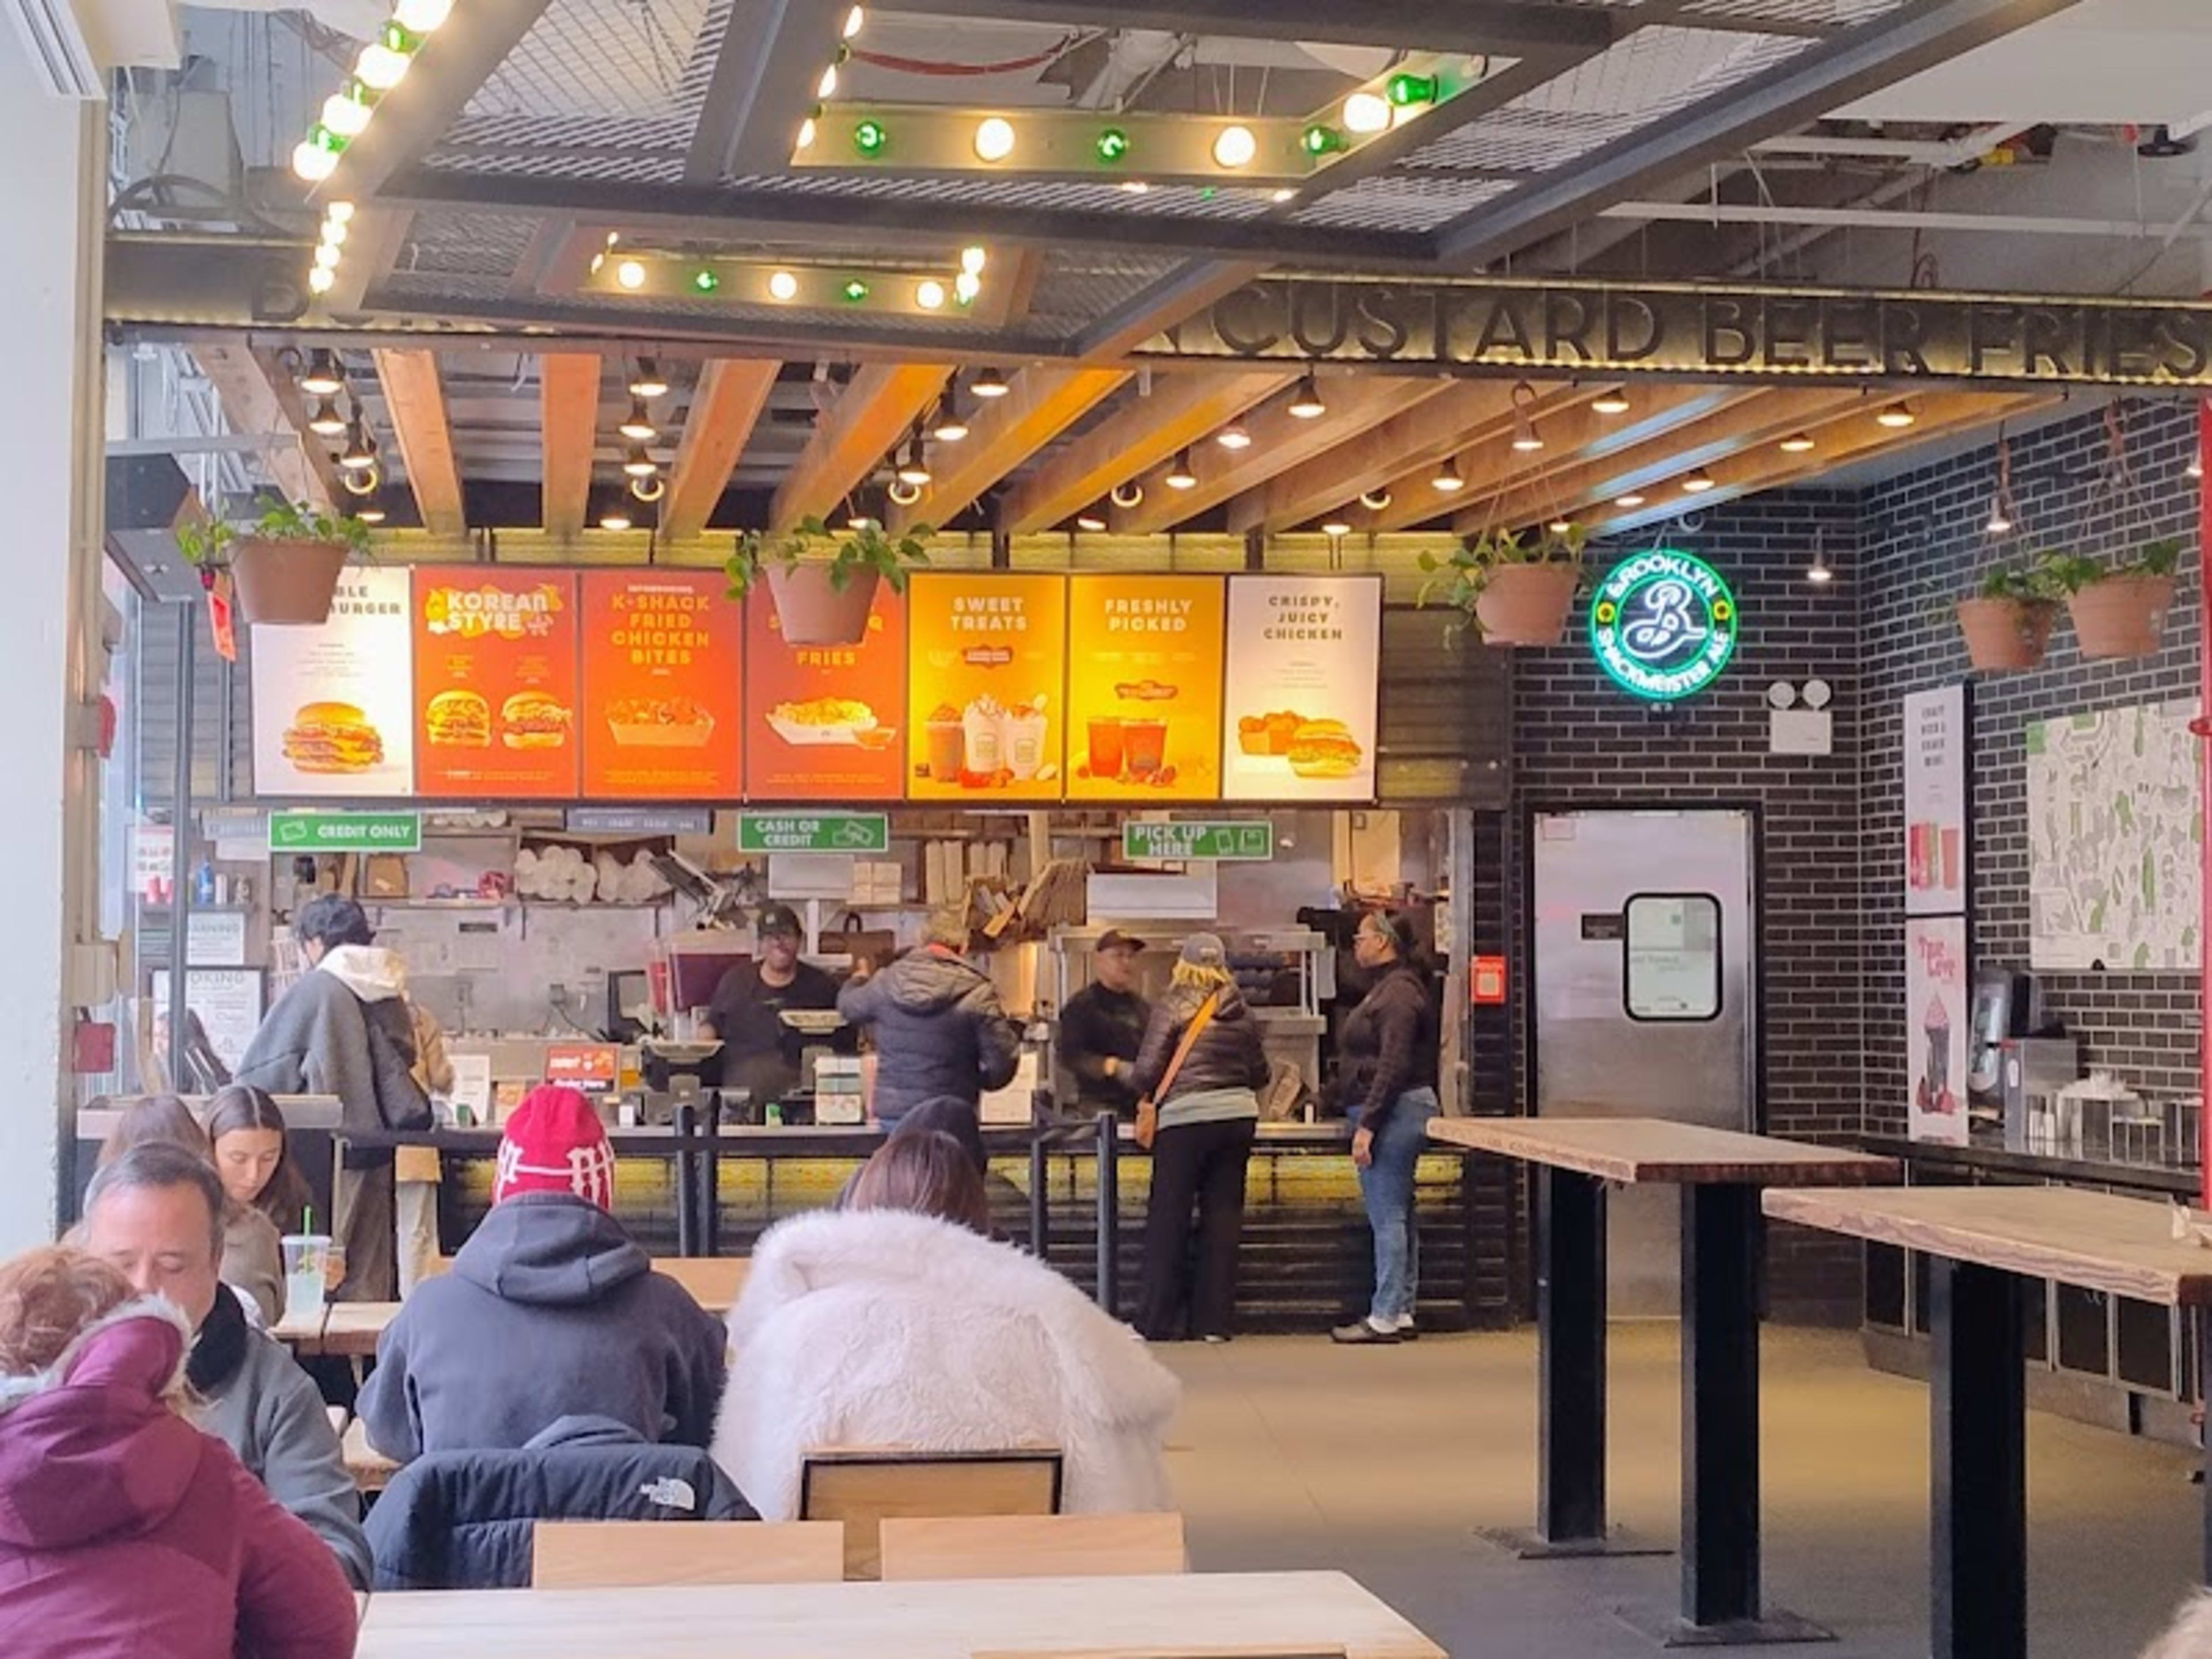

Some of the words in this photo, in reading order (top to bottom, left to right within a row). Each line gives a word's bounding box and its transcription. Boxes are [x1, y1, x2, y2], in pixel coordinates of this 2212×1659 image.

[1211, 286, 1662, 362] CUSTARD
[1704, 300, 1929, 374] BEER
[1969, 308, 2209, 379] FRIES
[1606, 554, 1719, 597] BROOKLYN
[447, 591, 548, 612] KOREAN
[612, 596, 710, 611] K-SHACK
[953, 597, 1024, 612] SWEET
[1105, 599, 1192, 613] FRESHLY
[1268, 596, 1340, 608] CRISPY,
[630, 613, 691, 629] FRIED
[950, 615, 1027, 631] TREATS
[1109, 617, 1187, 631] PICKED
[1278, 612, 1329, 623] JUICY
[611, 631, 709, 646] CHICKEN
[1263, 628, 1343, 640] CHICKEN
[631, 649, 691, 665] BITES
[797, 651, 855, 666] FRIES
[317, 824, 367, 839] CREDIT
[369, 824, 410, 838] ONLY
[755, 820, 796, 832] CASH
[799, 820, 820, 833] OR
[1134, 827, 1177, 840] PICK
[1181, 826, 1207, 840] UP
[764, 834, 814, 846] CREDIT
[1149, 842, 1193, 855] HERE
